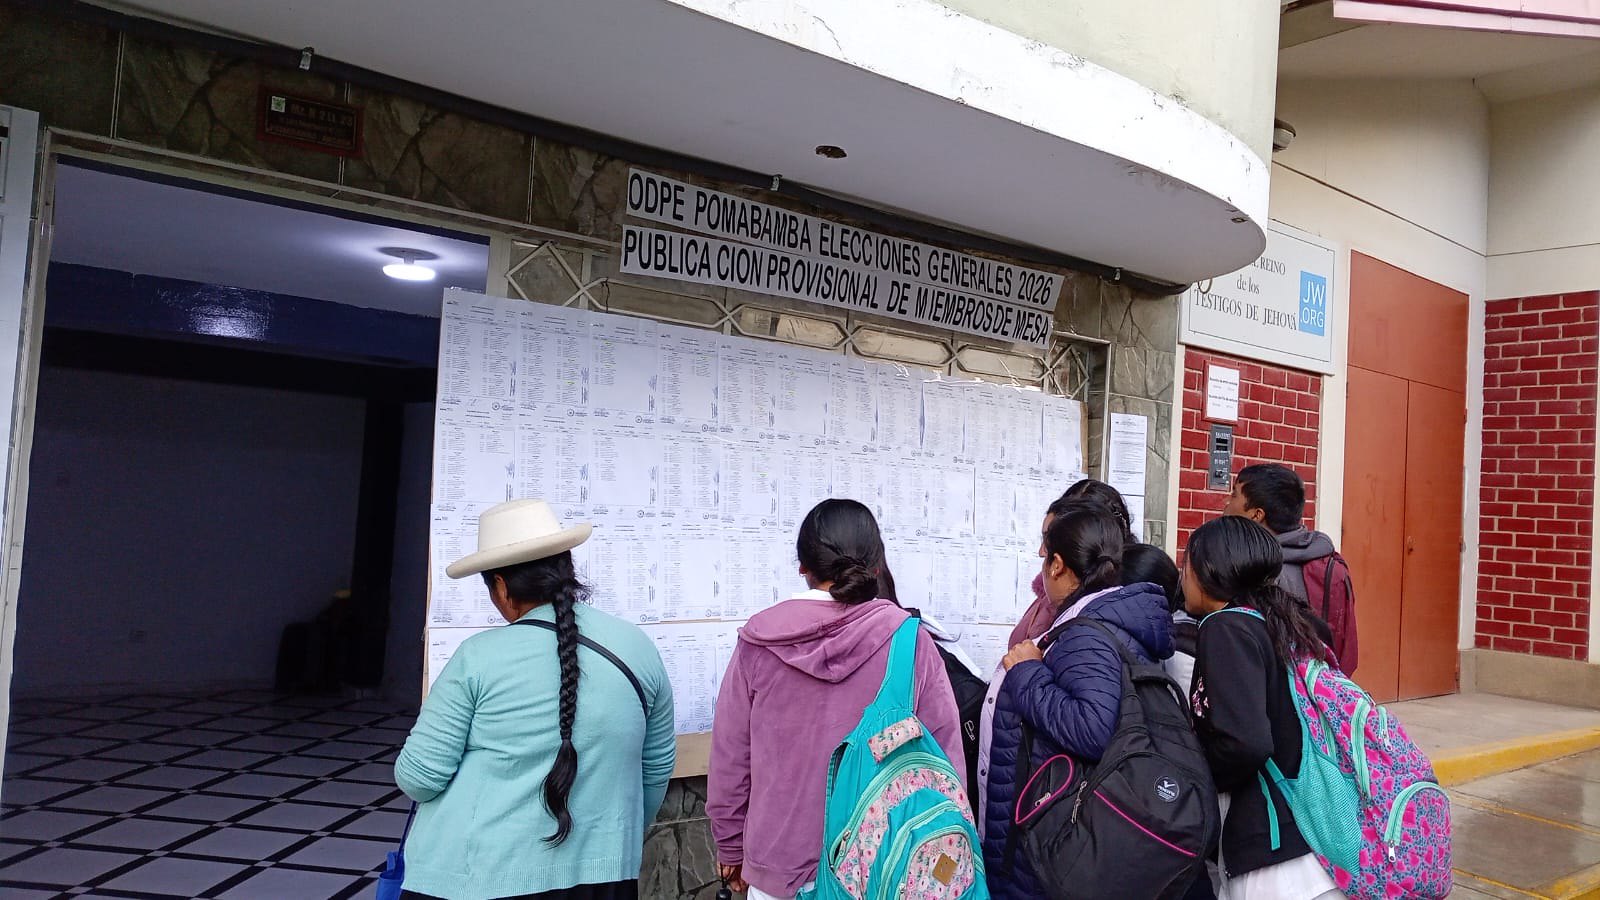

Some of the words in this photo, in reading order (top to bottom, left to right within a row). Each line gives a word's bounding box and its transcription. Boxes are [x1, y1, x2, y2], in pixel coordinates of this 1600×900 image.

[629, 173, 685, 221] ODPE
[695, 190, 811, 252] POMABAMBA
[819, 223, 920, 277] ELECCIONES
[928, 250, 1013, 297] GENERALES
[1018, 271, 1053, 305] 2026
[1260, 256, 1286, 275] REINO
[1237, 274, 1247, 291] de
[1248, 276, 1260, 294] los
[1303, 281, 1325, 307] JW
[767, 254, 878, 309] PROVISIONAL
[886, 280, 911, 315] DE
[1012, 310, 1049, 345] MESA
[1194, 289, 1242, 317] TESTIGOS
[1246, 303, 1259, 321] DE
[1262, 307, 1297, 331] JEHOVÁ
[1300, 307, 1324, 328] .ORG
